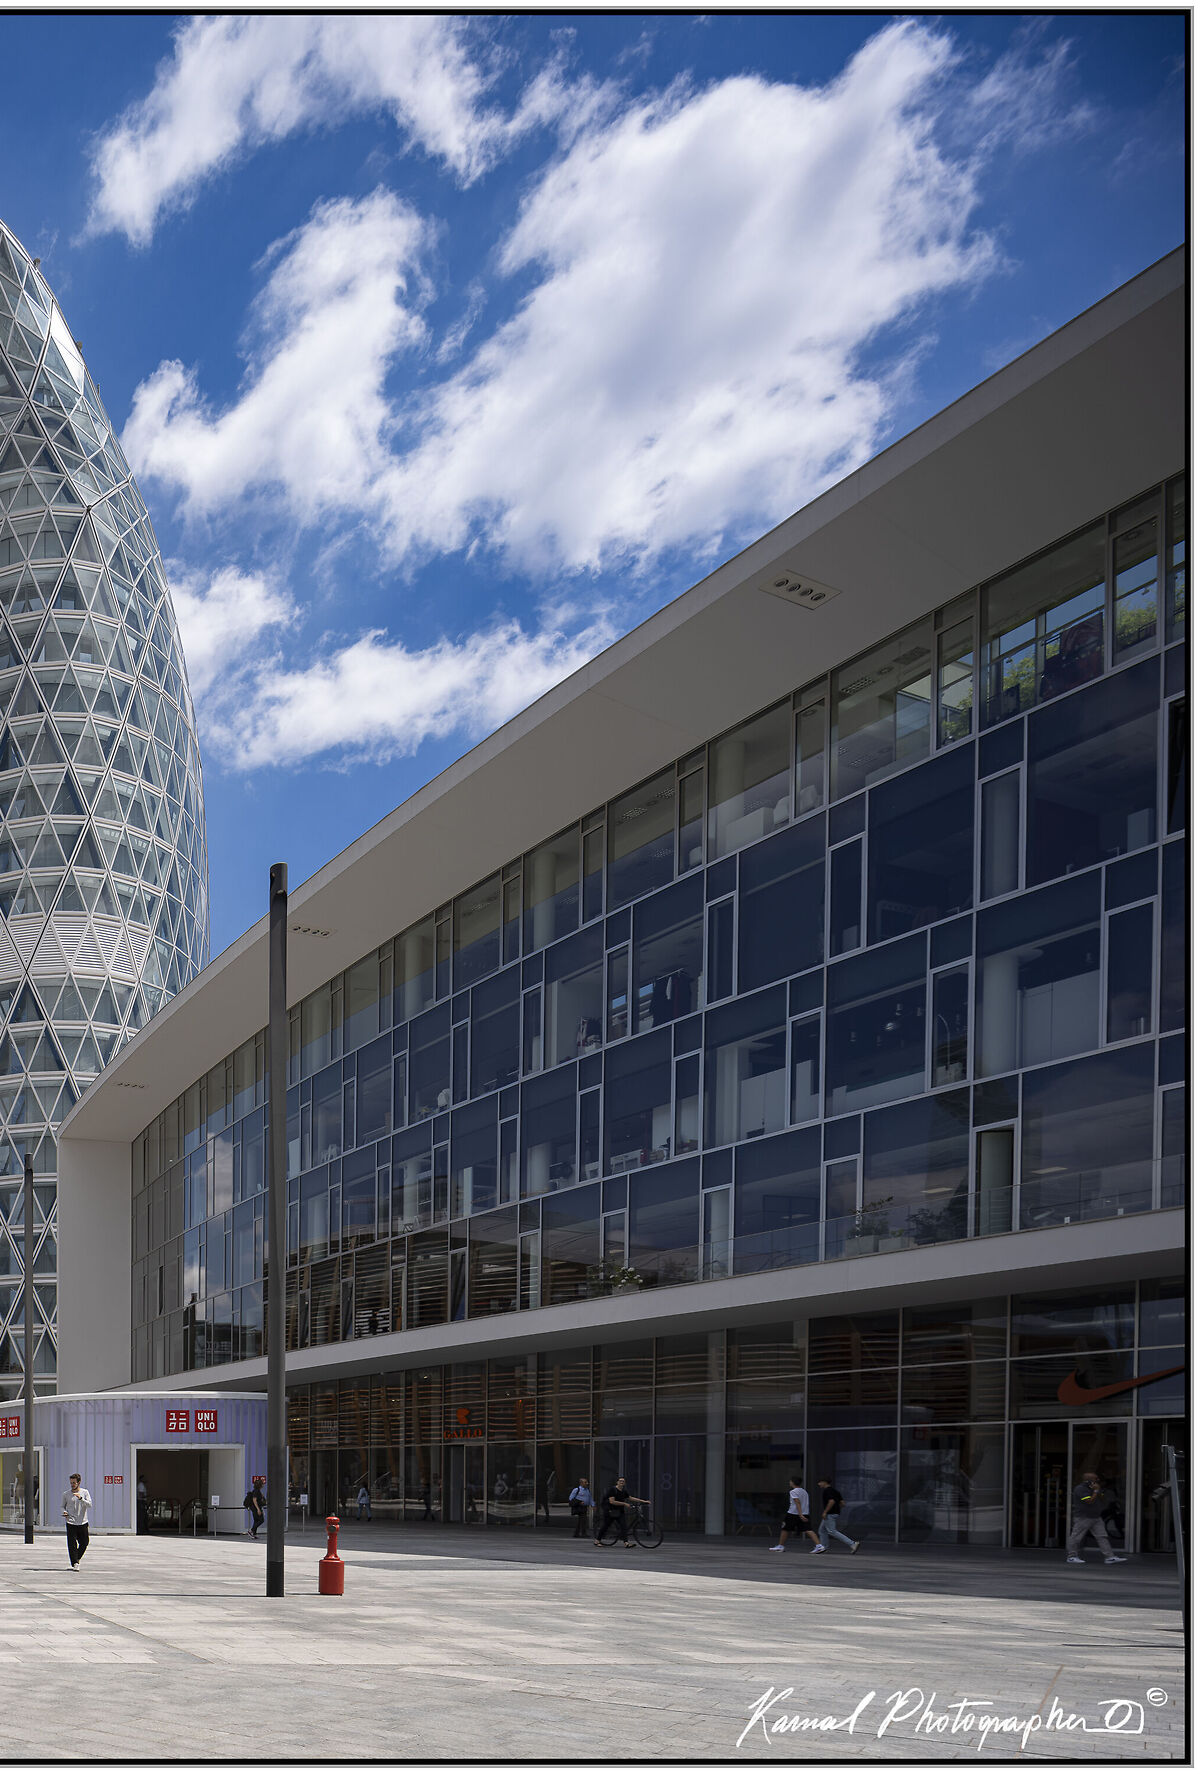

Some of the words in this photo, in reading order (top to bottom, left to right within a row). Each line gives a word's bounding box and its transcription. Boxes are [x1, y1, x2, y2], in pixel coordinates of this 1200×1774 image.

[197, 1412, 214, 1421] UNI
[197, 1421, 215, 1431] QLO
[443, 1429, 483, 1439] GALLO
